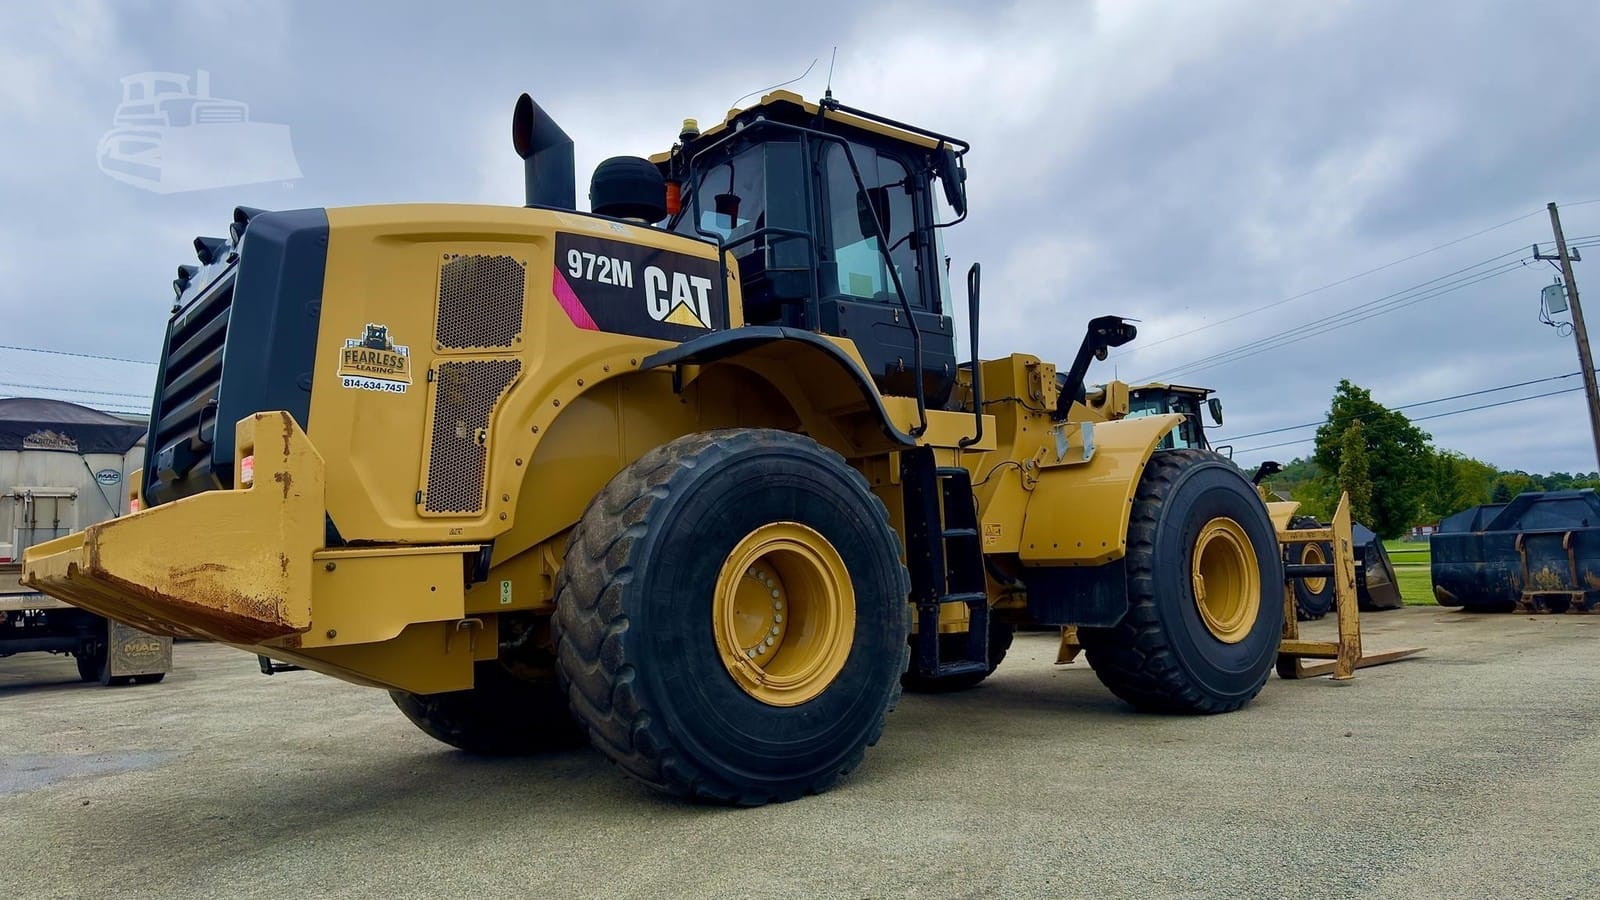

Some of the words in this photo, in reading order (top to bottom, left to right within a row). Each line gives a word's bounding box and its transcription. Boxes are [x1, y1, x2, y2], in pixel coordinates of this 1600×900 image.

[567, 249, 634, 288] 972M
[643, 265, 713, 329] CAT
[344, 350, 405, 369] FEARLESS
[355, 364, 394, 375] LEASING
[343, 379, 406, 392] 814-634-7451
[124, 642, 161, 653] MAC
